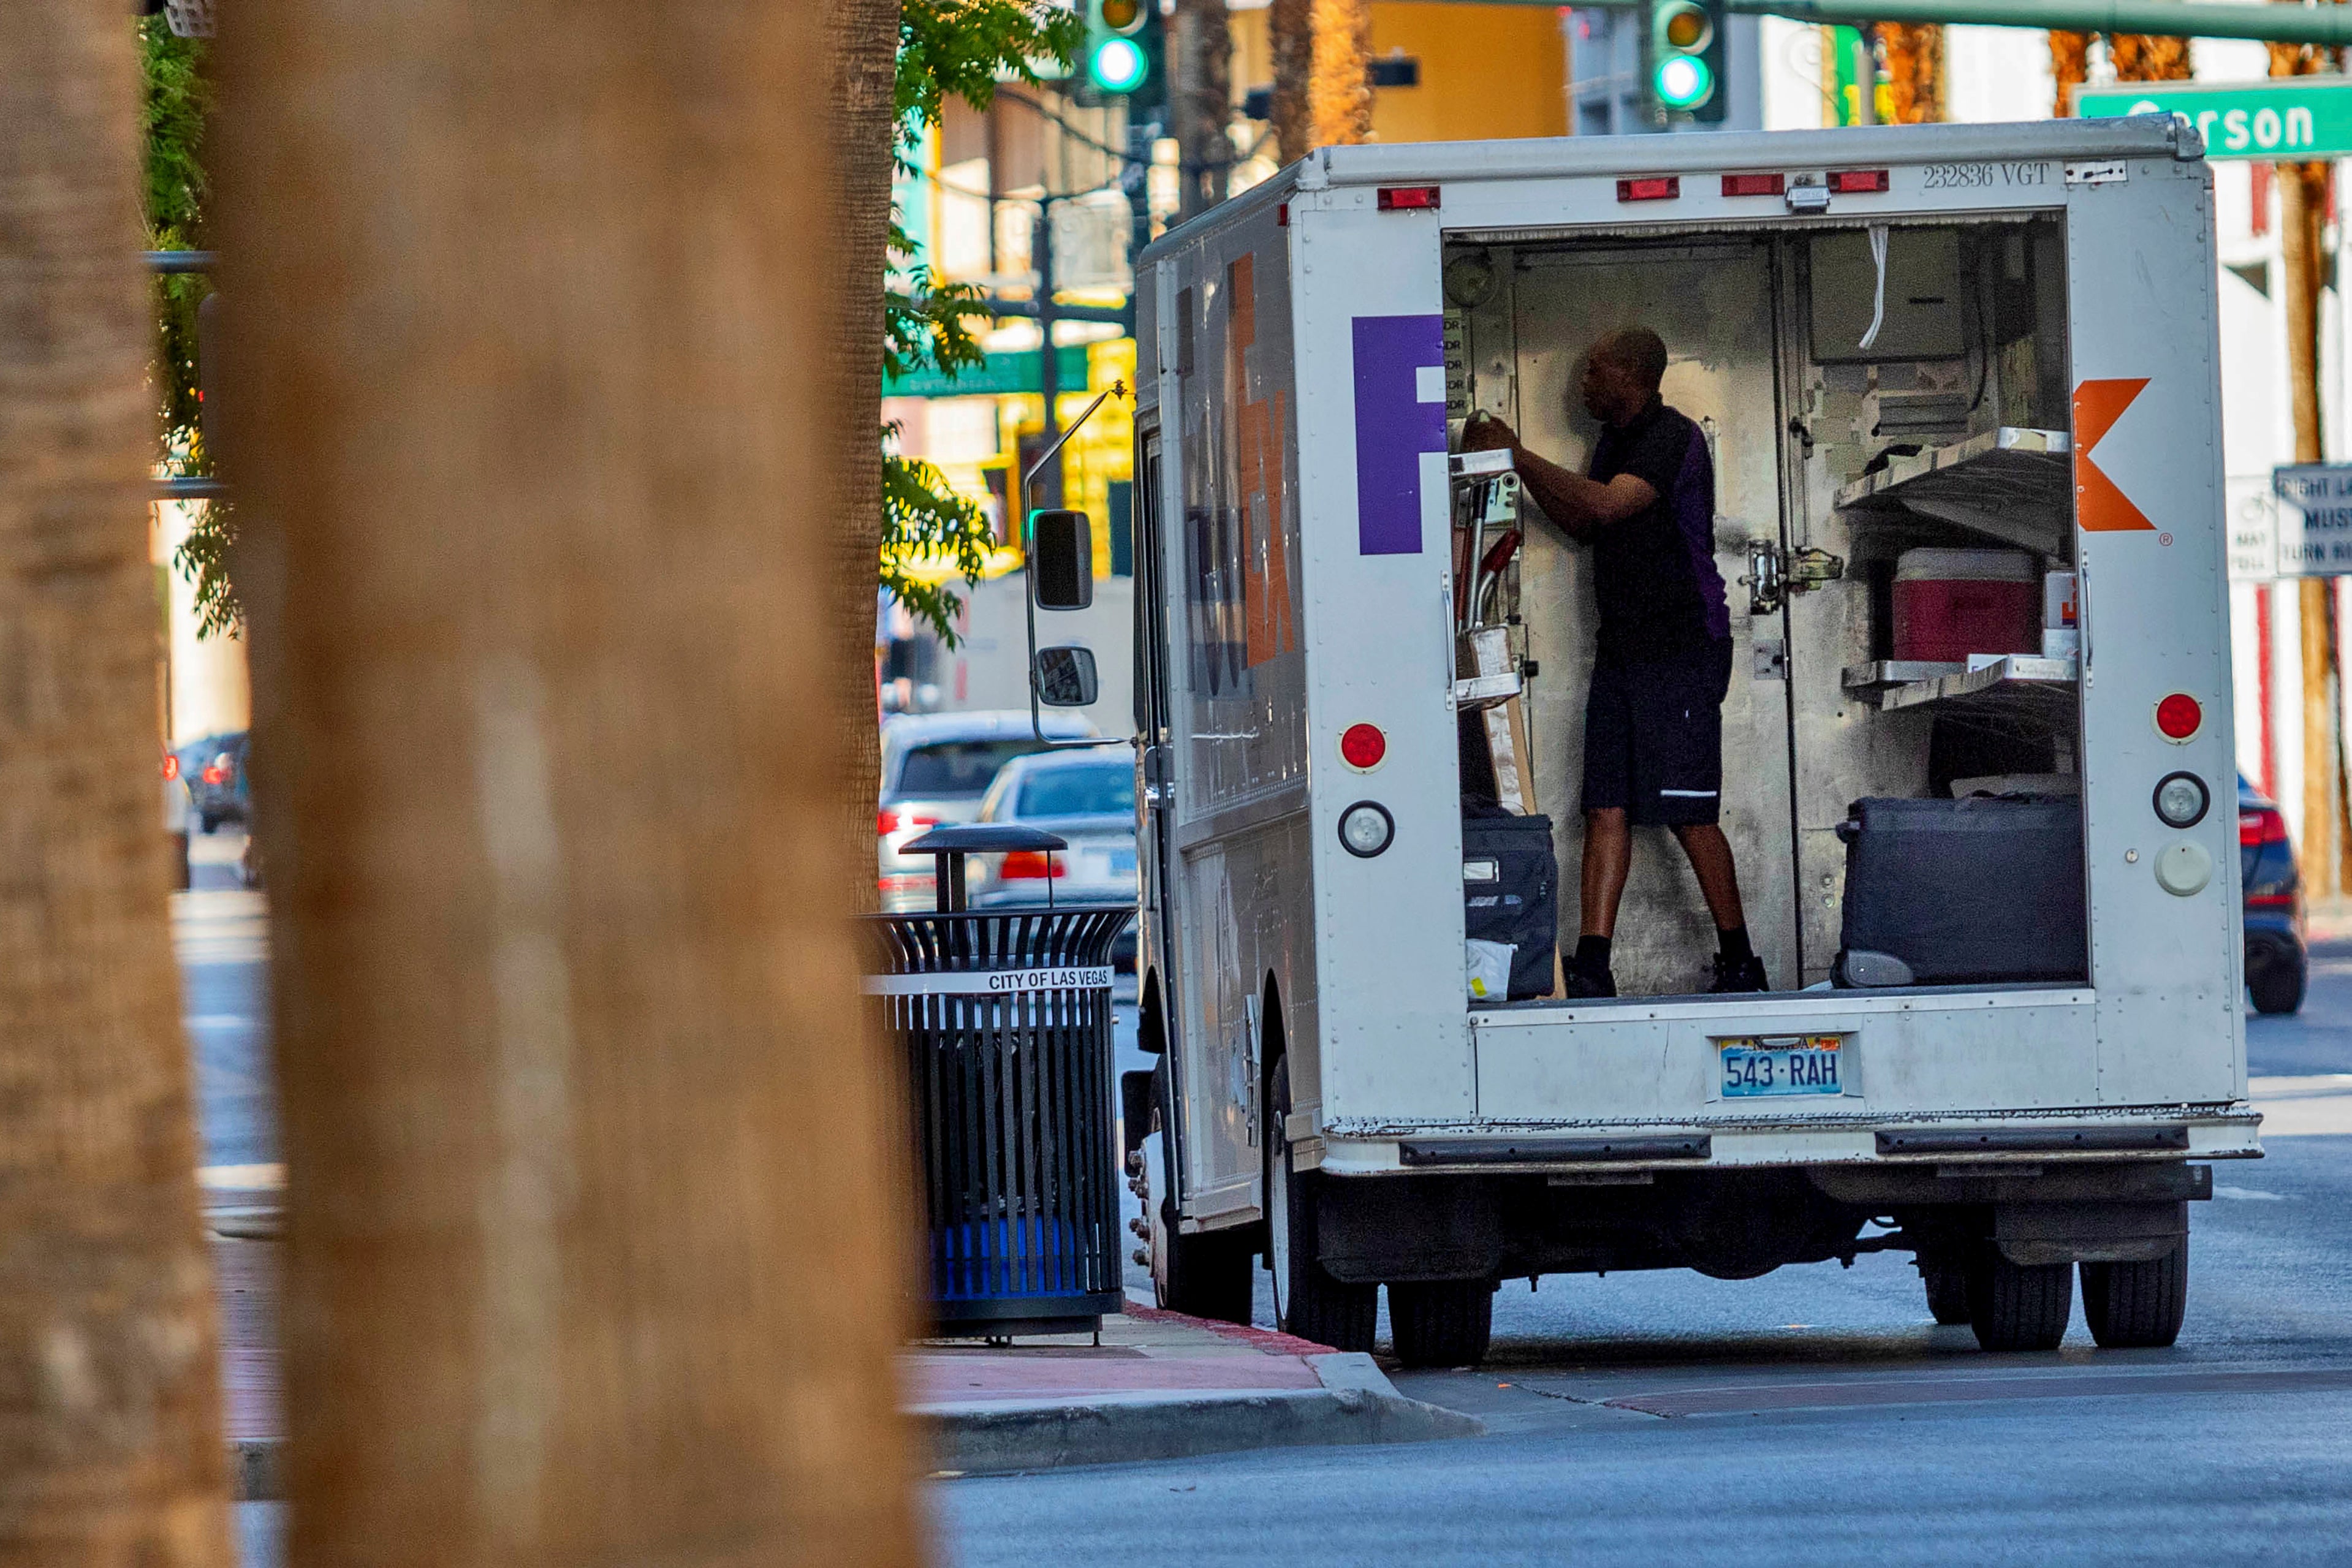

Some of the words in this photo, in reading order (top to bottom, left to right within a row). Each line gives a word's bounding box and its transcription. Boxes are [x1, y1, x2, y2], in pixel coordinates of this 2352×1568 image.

[2128, 100, 2313, 150] rson
[1924, 163, 1994, 189] 232836
[2000, 162, 2050, 186] VGT
[1443, 320, 1459, 330] DR
[1444, 340, 1461, 350] DR
[1445, 360, 1463, 370] DR
[1447, 379, 1464, 390] DR
[2304, 508, 2352, 529] MUS
[988, 973, 1024, 990] CITY
[1028, 972, 1048, 987] OF
[1051, 971, 1076, 986] LAS
[1079, 970, 1108, 986] VEGAS
